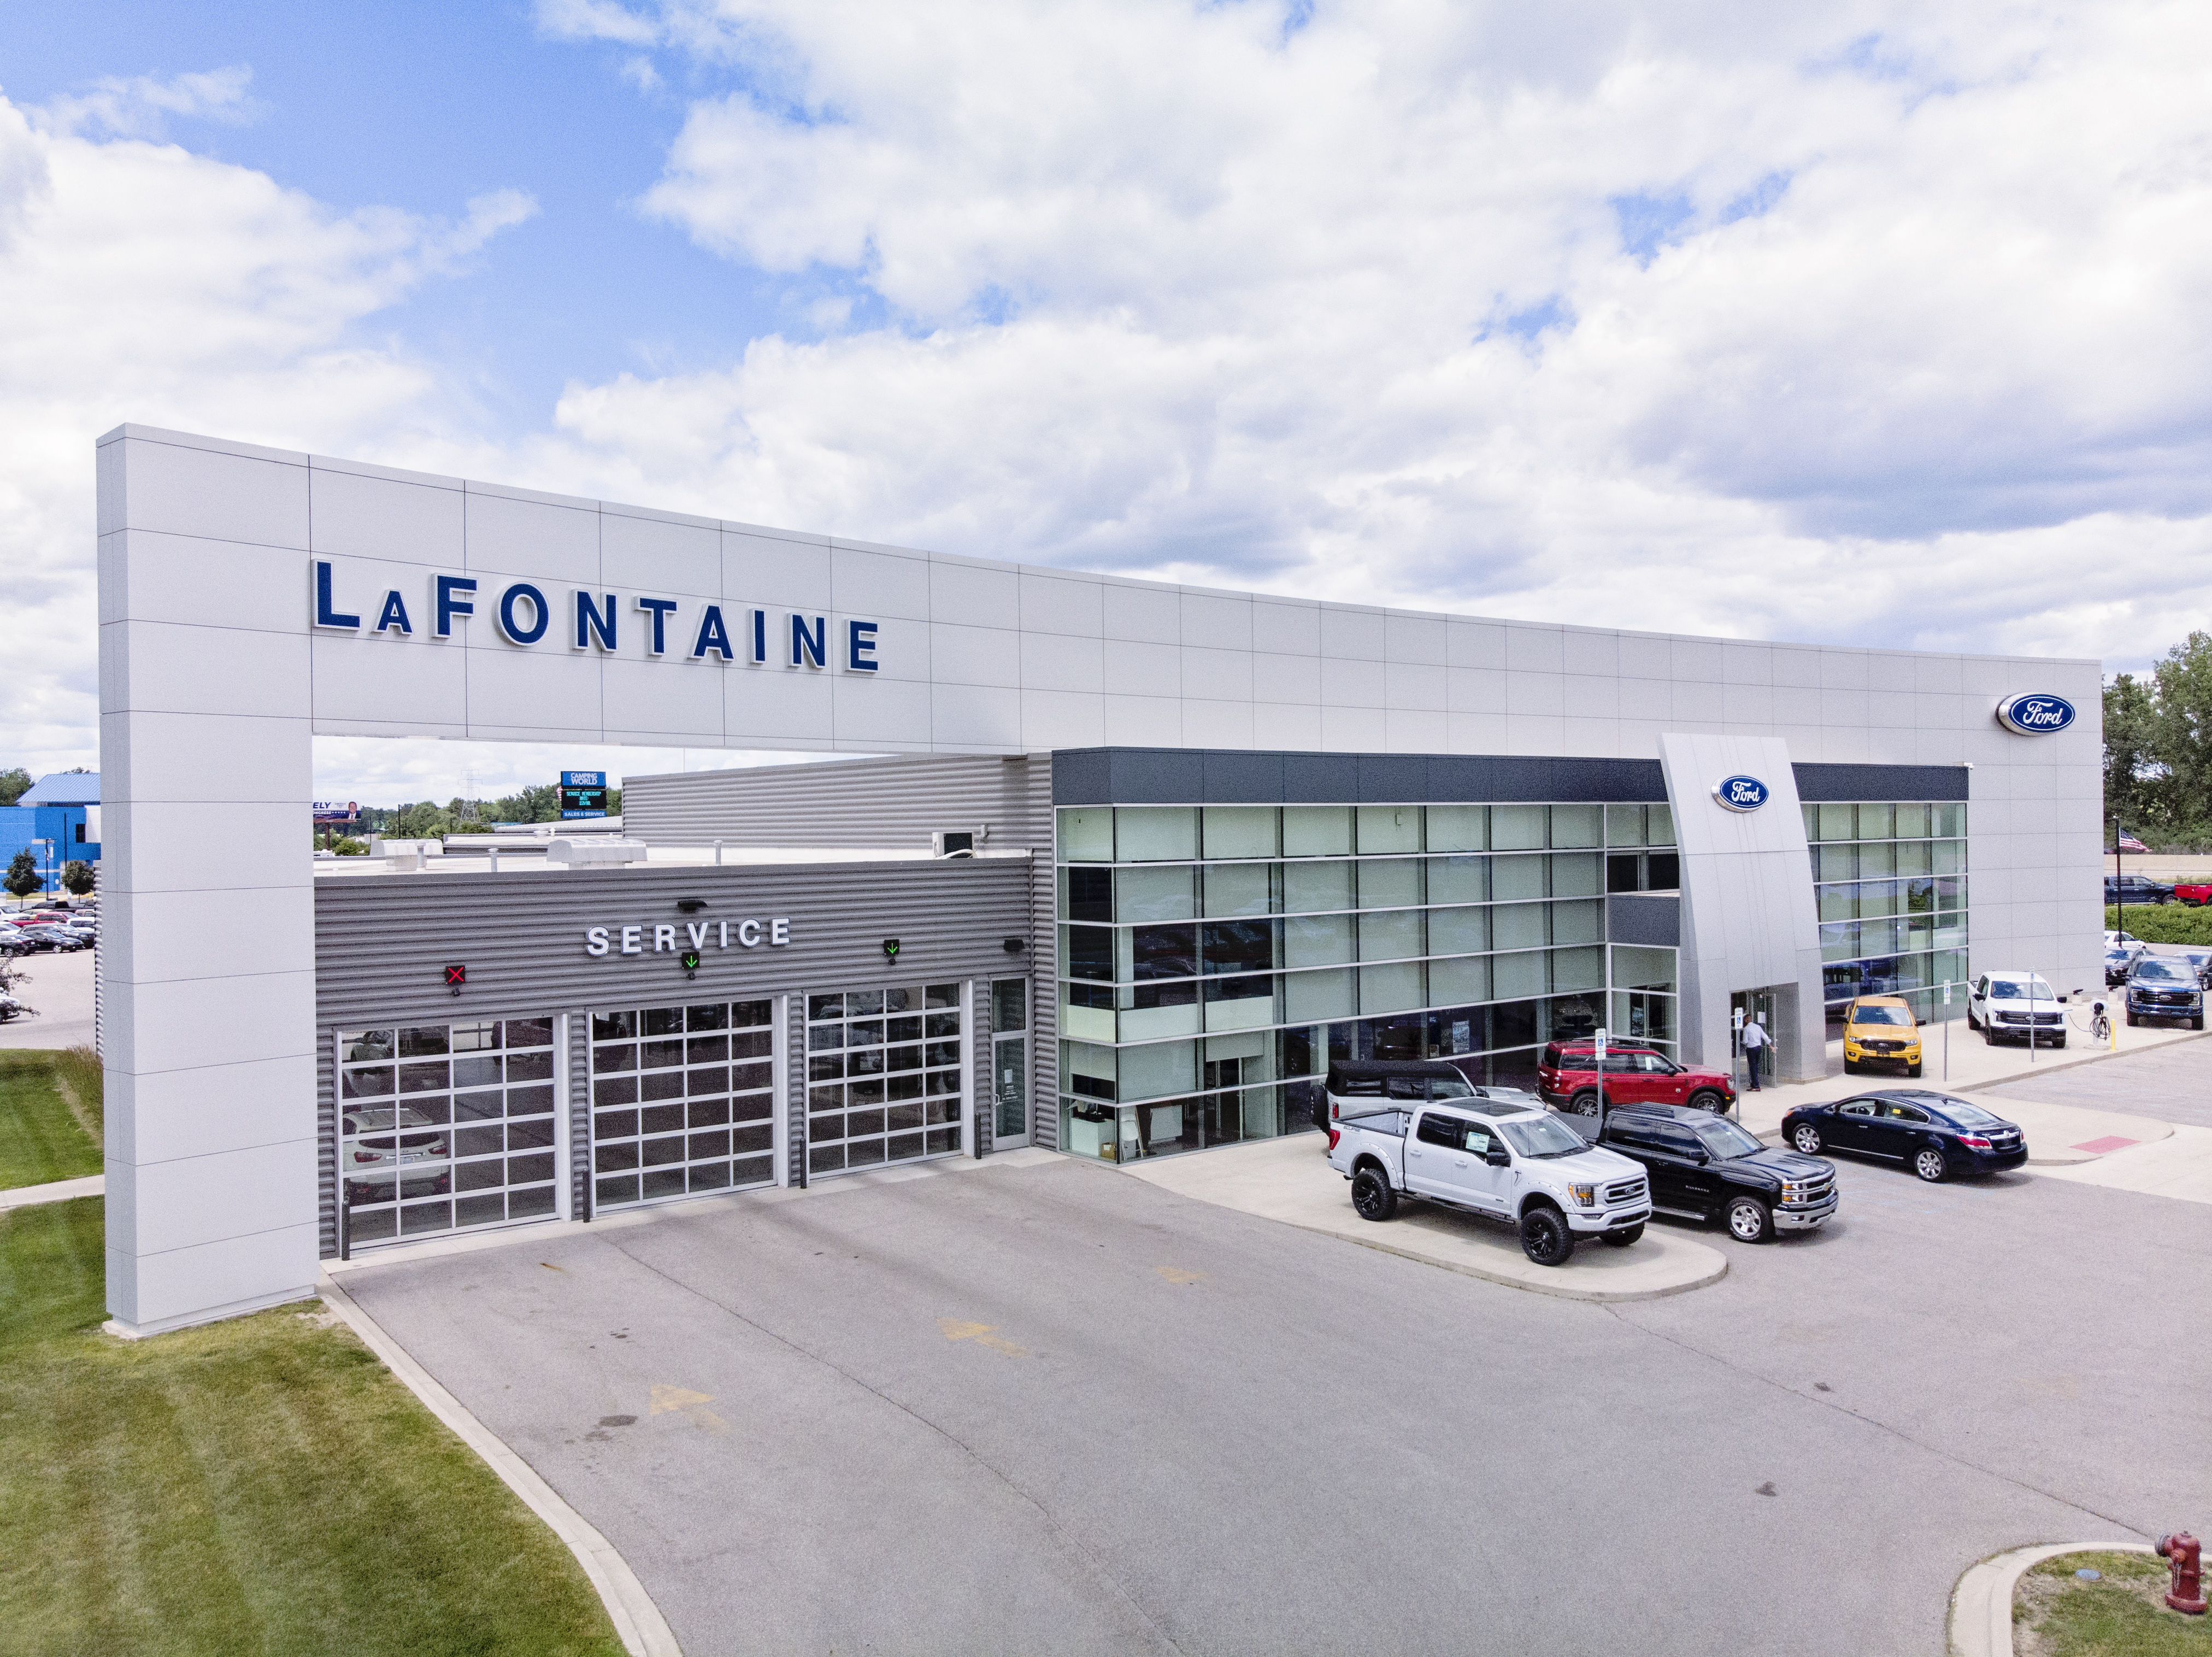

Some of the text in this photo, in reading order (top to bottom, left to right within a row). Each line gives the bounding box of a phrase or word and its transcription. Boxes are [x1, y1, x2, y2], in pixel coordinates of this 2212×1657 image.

[2023, 701, 2063, 725] Ford
[1731, 782, 1760, 802] Ford
[586, 918, 790, 956] SERVICE
